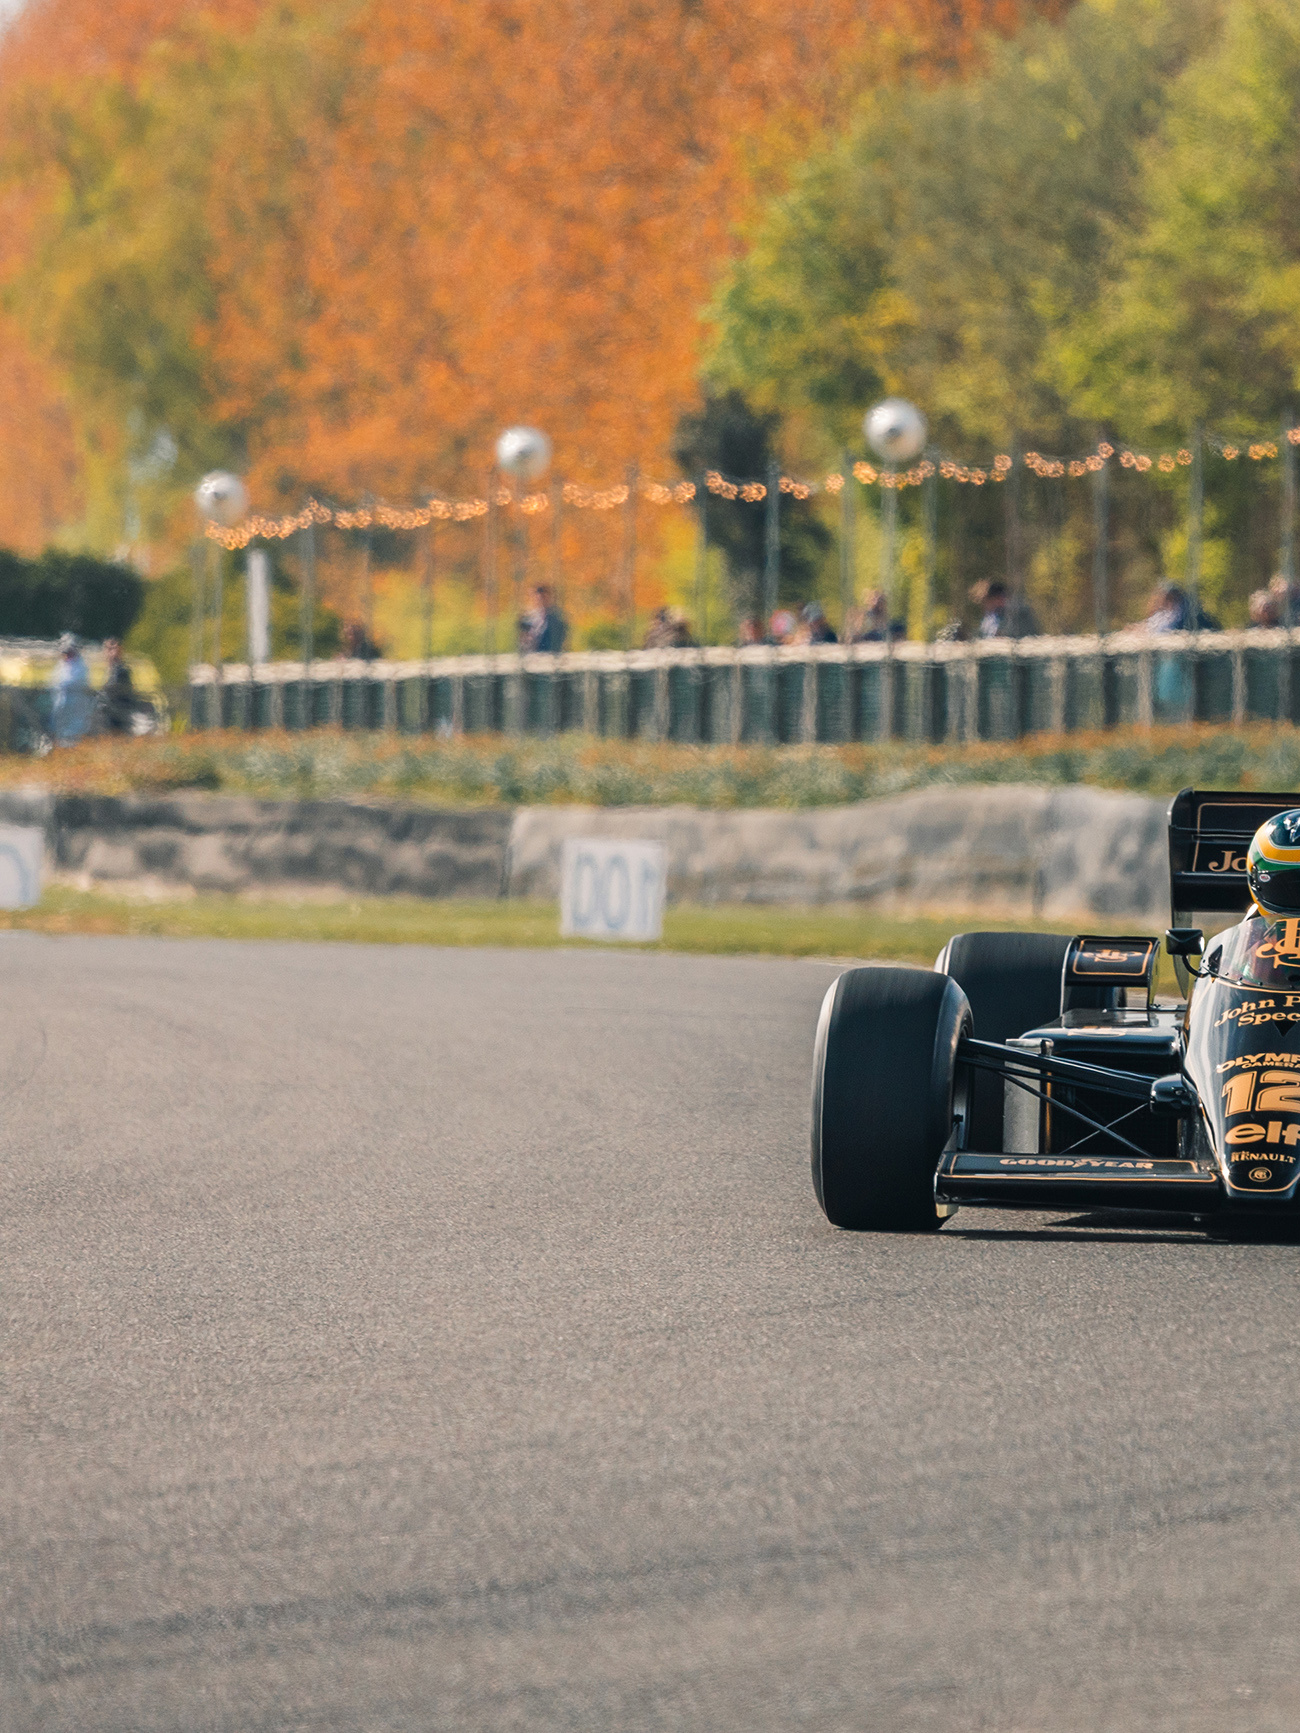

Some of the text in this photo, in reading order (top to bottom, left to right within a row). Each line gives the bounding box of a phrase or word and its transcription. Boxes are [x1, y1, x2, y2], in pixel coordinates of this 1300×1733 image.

[1208, 850, 1248, 872] Jo
[1214, 998, 1276, 1027] John
[999, 1159, 1154, 1169] GOODYEAR
